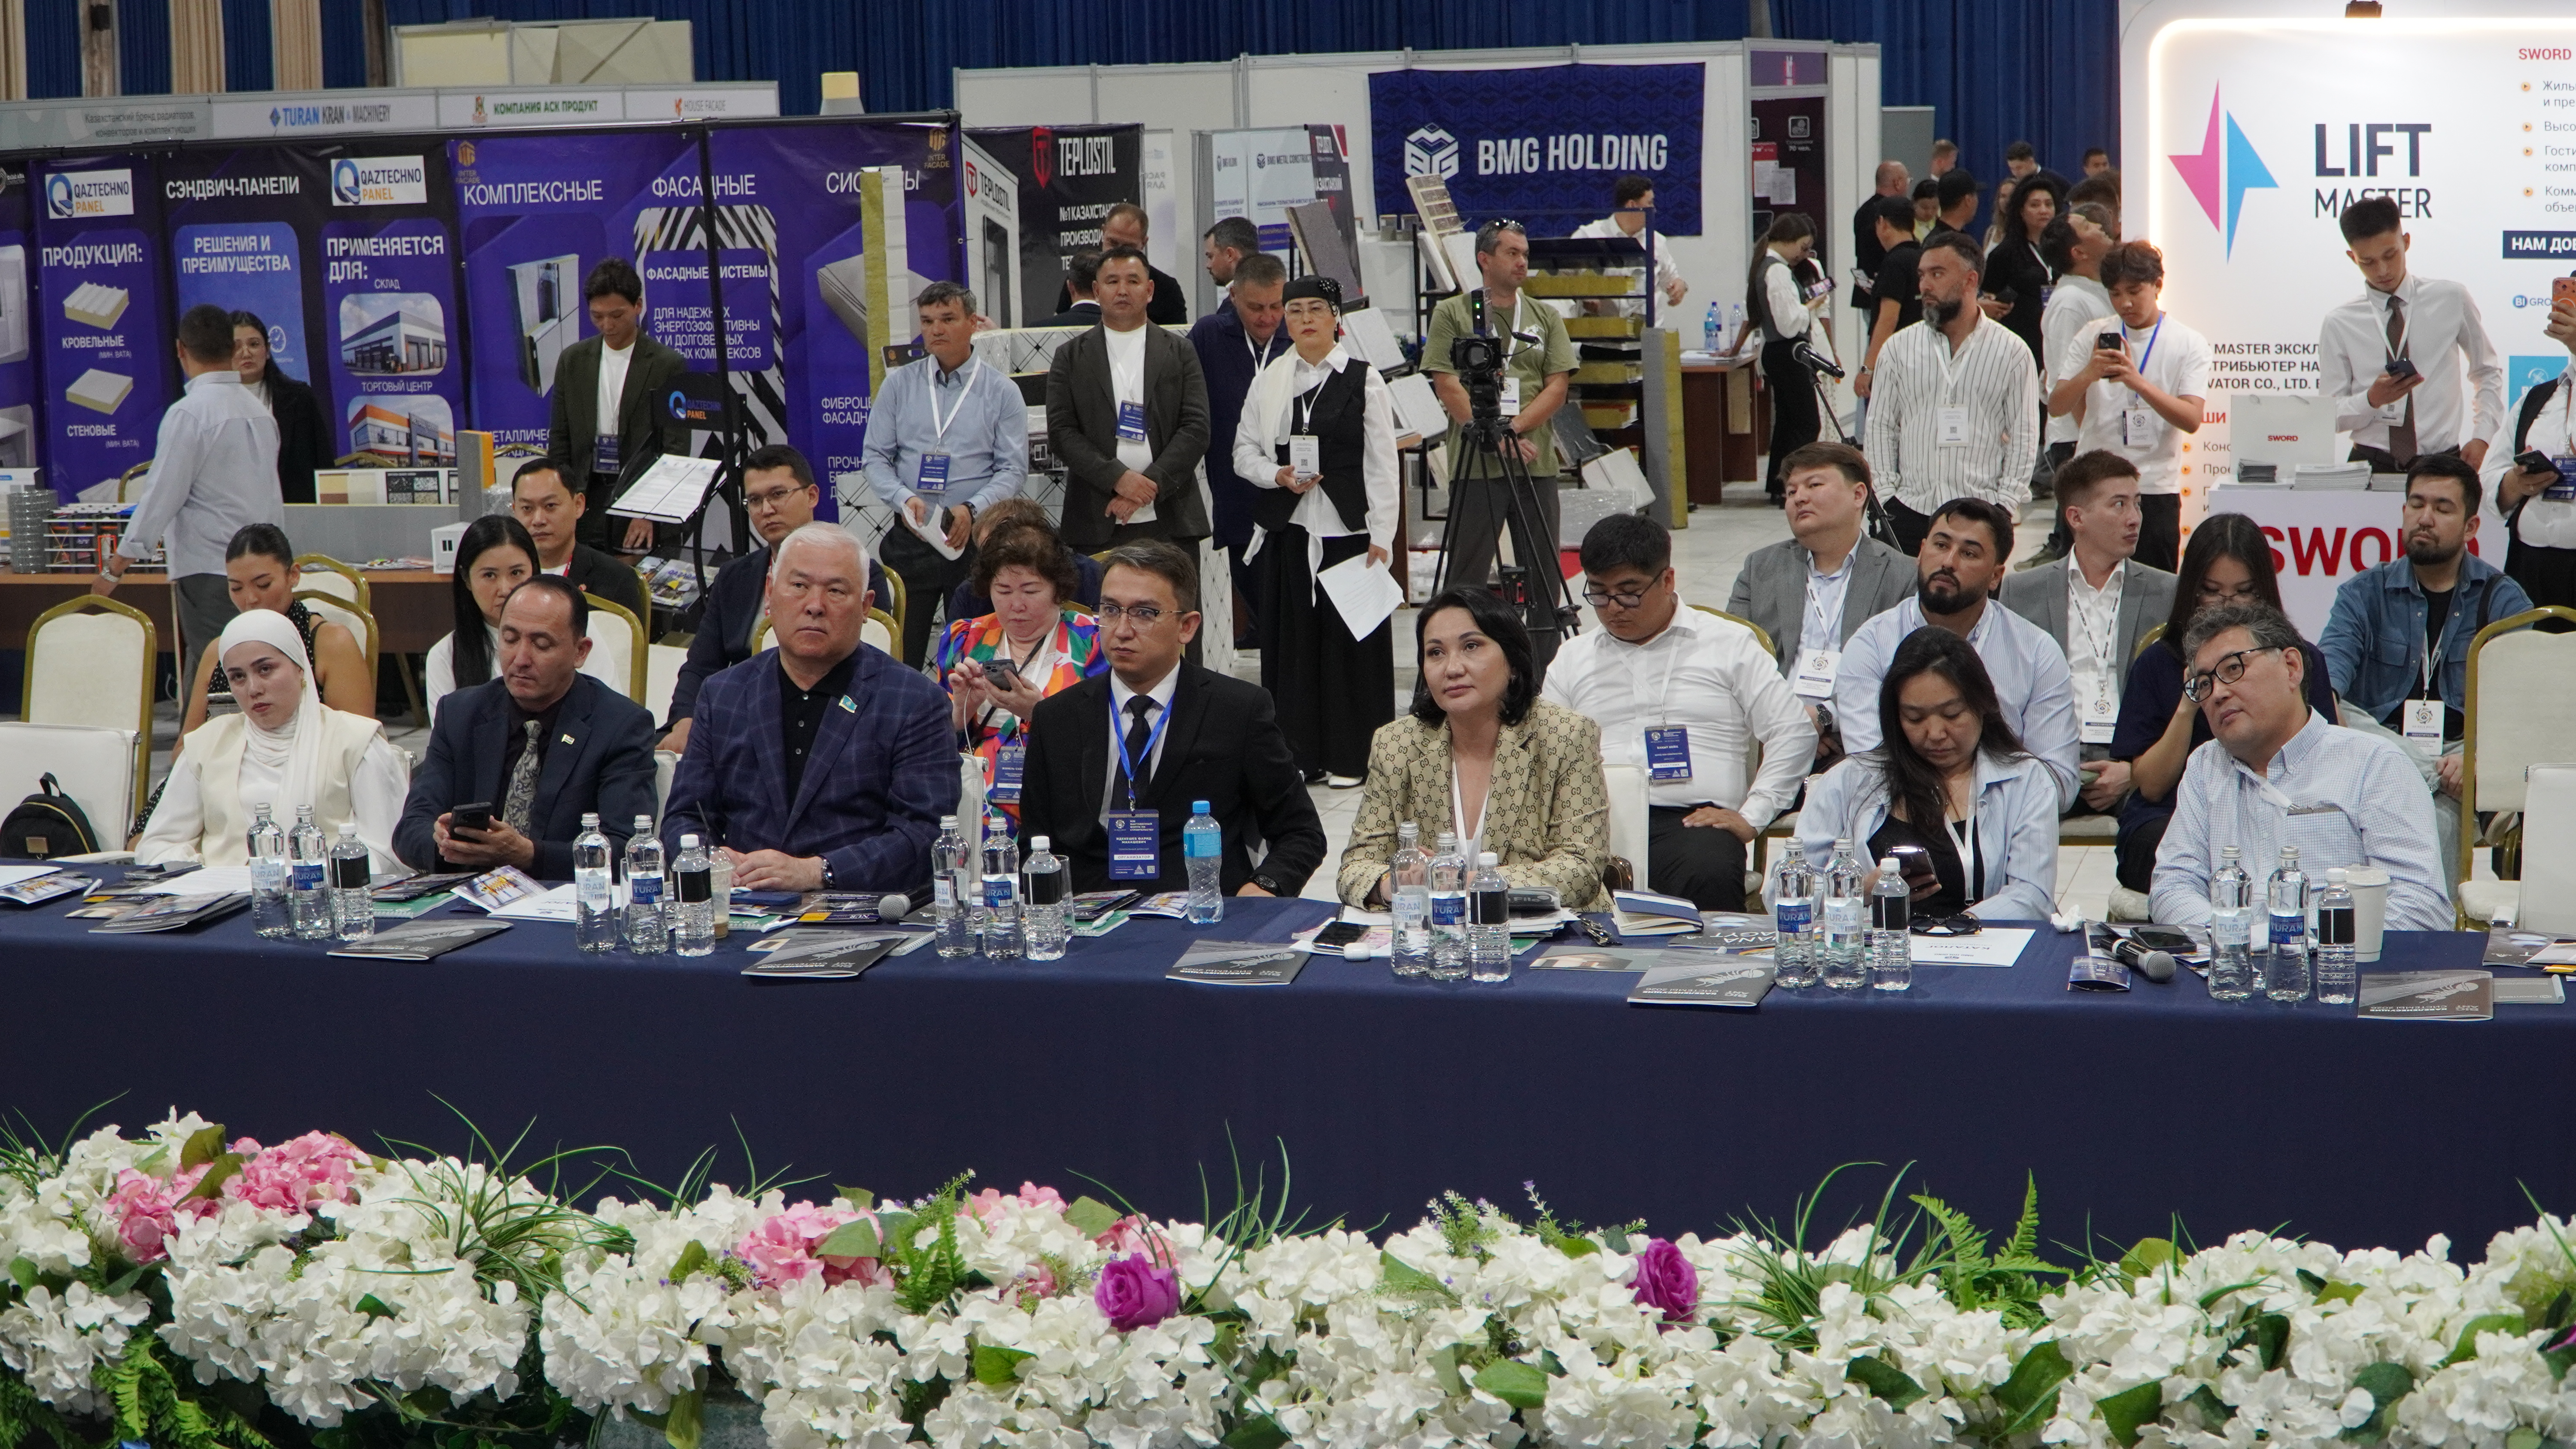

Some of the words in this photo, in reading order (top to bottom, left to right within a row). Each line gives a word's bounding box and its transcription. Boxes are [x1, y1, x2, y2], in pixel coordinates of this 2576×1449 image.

[2519, 49, 2572, 60] SWORD
[494, 101, 541, 115] КОМПАНИЯ
[544, 100, 560, 112] АСК
[562, 100, 598, 114] ПРОДУКТ
[684, 100, 704, 112] HOUSE
[282, 107, 321, 126] TURAN
[322, 106, 344, 124] KRAN
[352, 104, 391, 123] MACHINERY
[1058, 136, 1116, 176] TEPLOSTIL
[1478, 137, 1540, 176] BMG
[1548, 133, 1668, 172] HOLDING
[2315, 124, 2432, 177] LIFT
[924, 161, 950, 169] FACADE
[361, 168, 422, 185] QAZTECHNO
[74, 181, 129, 198] QAZTECHNO
[166, 176, 300, 200] СЭНДВИЧ-ПАНЕЛИ
[362, 188, 395, 200] PANEL
[464, 179, 603, 205] КОМПЛЕКСНЫЕ
[980, 171, 1011, 212] TEPLOSTIL
[76, 200, 105, 212] PANEL
[2315, 188, 2432, 219] MAER
[194, 235, 258, 253] РЕШЕНИЯ
[261, 235, 271, 251] И
[327, 235, 444, 257] ПРИМЕНЯЕТСЯ
[2512, 237, 2546, 251] НАМ
[43, 243, 143, 269] ПРОДУКЦИЯ:
[182, 255, 292, 274] ПРЕИМУЩЕСТВА
[329, 261, 368, 284] ДЛЯ:
[647, 266, 709, 282] ФАСАДНЫЕ
[720, 265, 768, 278] ИСТЕМЫ
[374, 278, 401, 290] СКЛАД
[2515, 297, 2526, 306] BI
[2529, 297, 2552, 306] GRO
[654, 308, 674, 321] ДЛЯ
[677, 306, 730, 320] НАДЕЖНХ
[654, 319, 760, 333] ЭНЕРГОЭФФТИВНЫ
[62, 335, 125, 349] КРОВЕЛЬНЫЕ
[665, 335, 673, 346] И
[674, 333, 743, 347] ДОЛГОВЕЫХ
[695, 347, 762, 360] КОМЕКСОВ
[2215, 344, 2270, 355] MASTER
[2209, 361, 2297, 372] ТРИБЬЮТЕР
[361, 380, 406, 393] ТОРГОВЫЙ
[406, 381, 433, 393] ЦЕНТР
[2254, 378, 2280, 391] CO.,
[2284, 378, 2311, 389] LTD.
[687, 409, 707, 420] PANEL
[823, 411, 868, 426] ФАСАДН
[67, 424, 117, 437] СТЕНОВЫЕ
[492, 429, 550, 443] ЕТАЛЛИЧЕ
[2261, 525, 2480, 577] SWO
[576, 883, 605, 891] TURAN
[1780, 912, 1811, 921] TURAN
[1826, 913, 1856, 922] TURAN
[2271, 924, 2303, 933] TURAN
